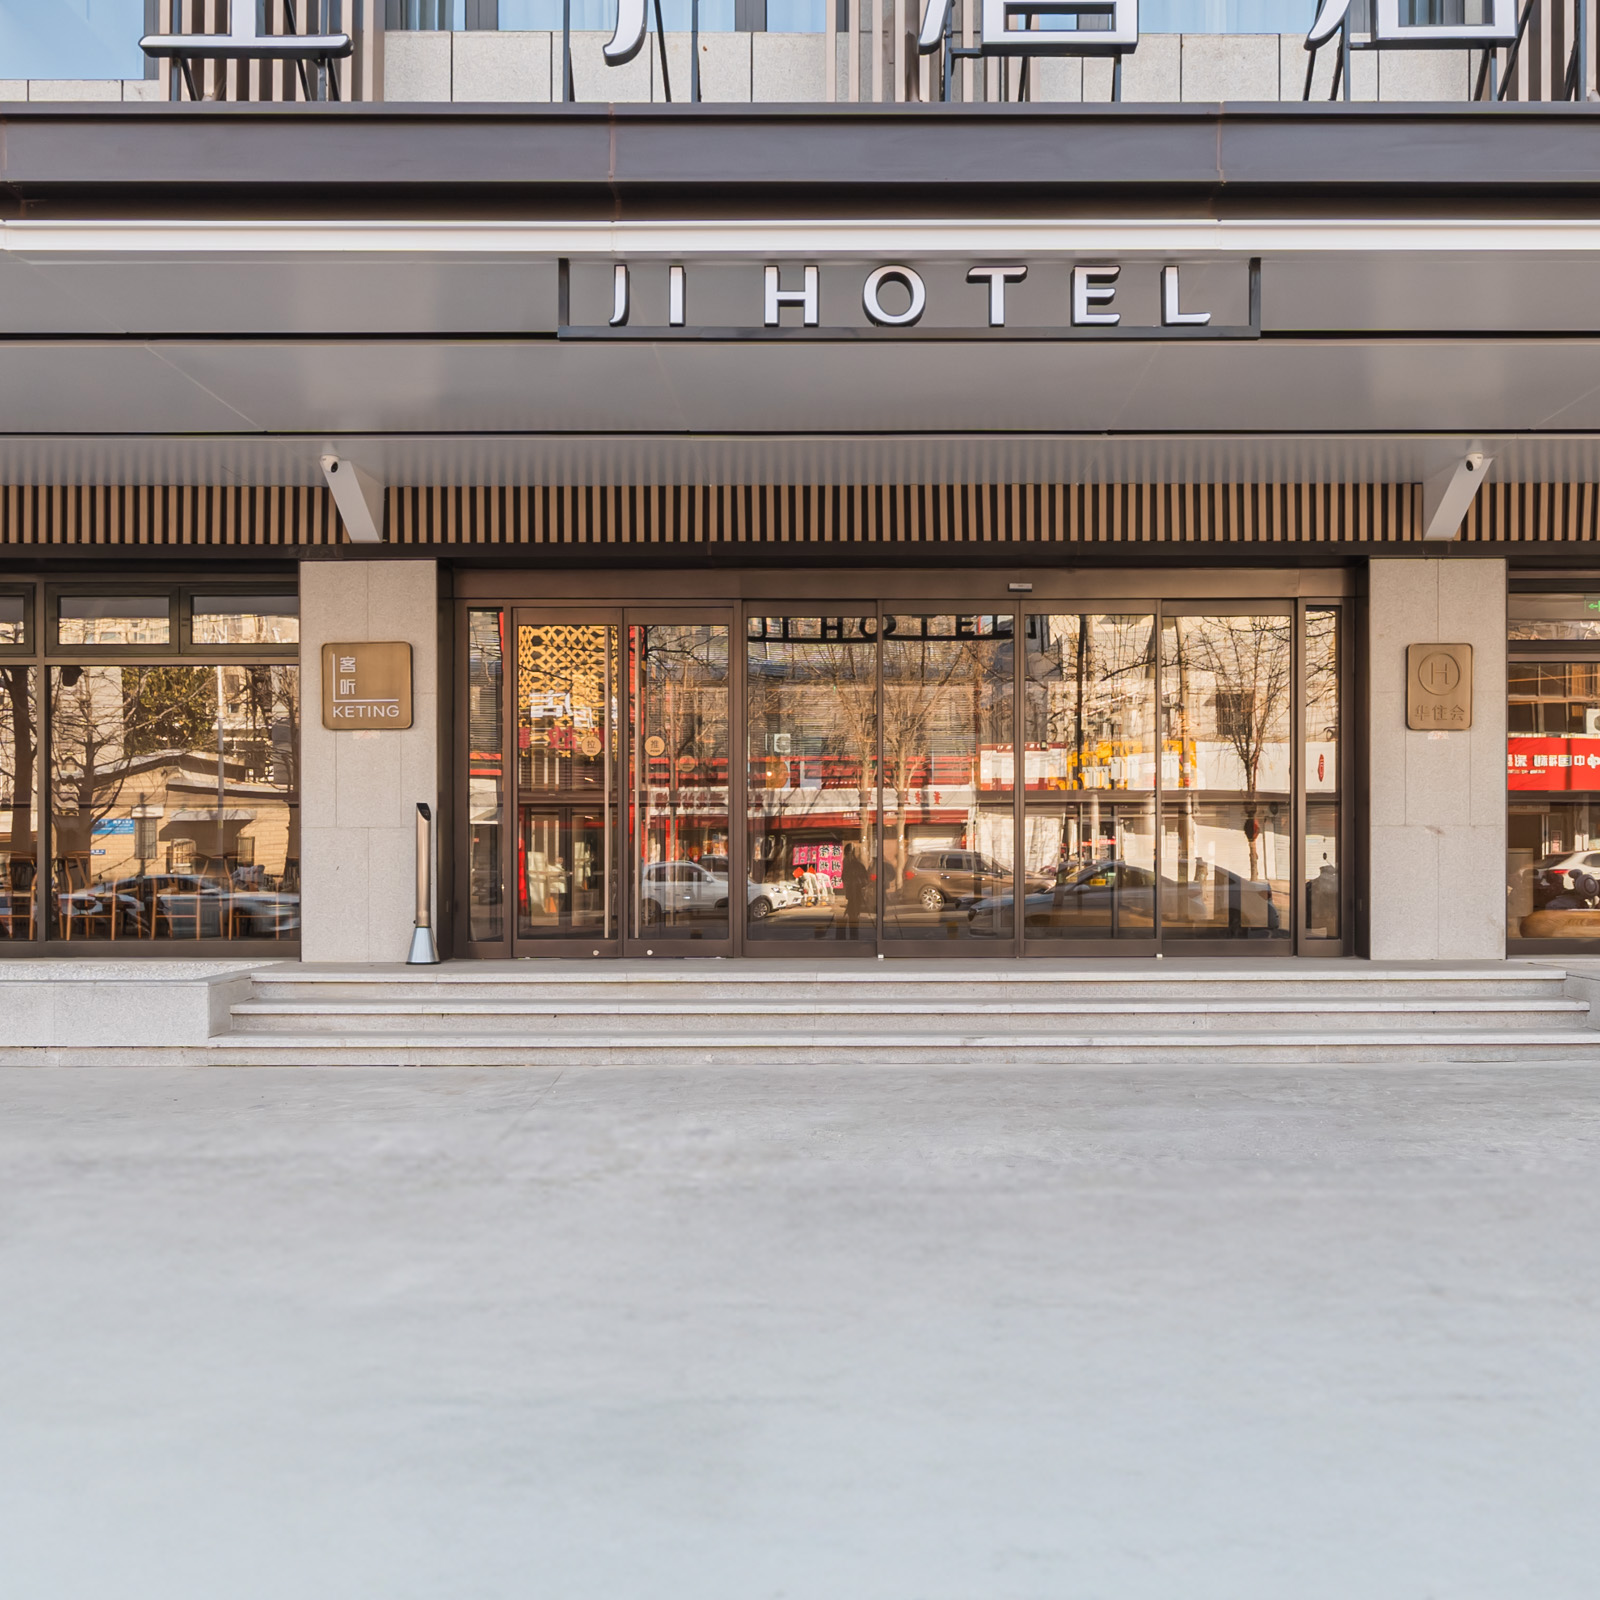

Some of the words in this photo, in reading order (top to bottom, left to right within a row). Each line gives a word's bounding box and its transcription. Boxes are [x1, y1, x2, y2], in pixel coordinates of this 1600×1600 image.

[608, 264, 686, 328] JI
[763, 264, 1212, 329] HOTEL
[339, 655, 357, 695] 客听
[332, 704, 400, 719] KETING
[1414, 704, 1465, 722] 华住会
